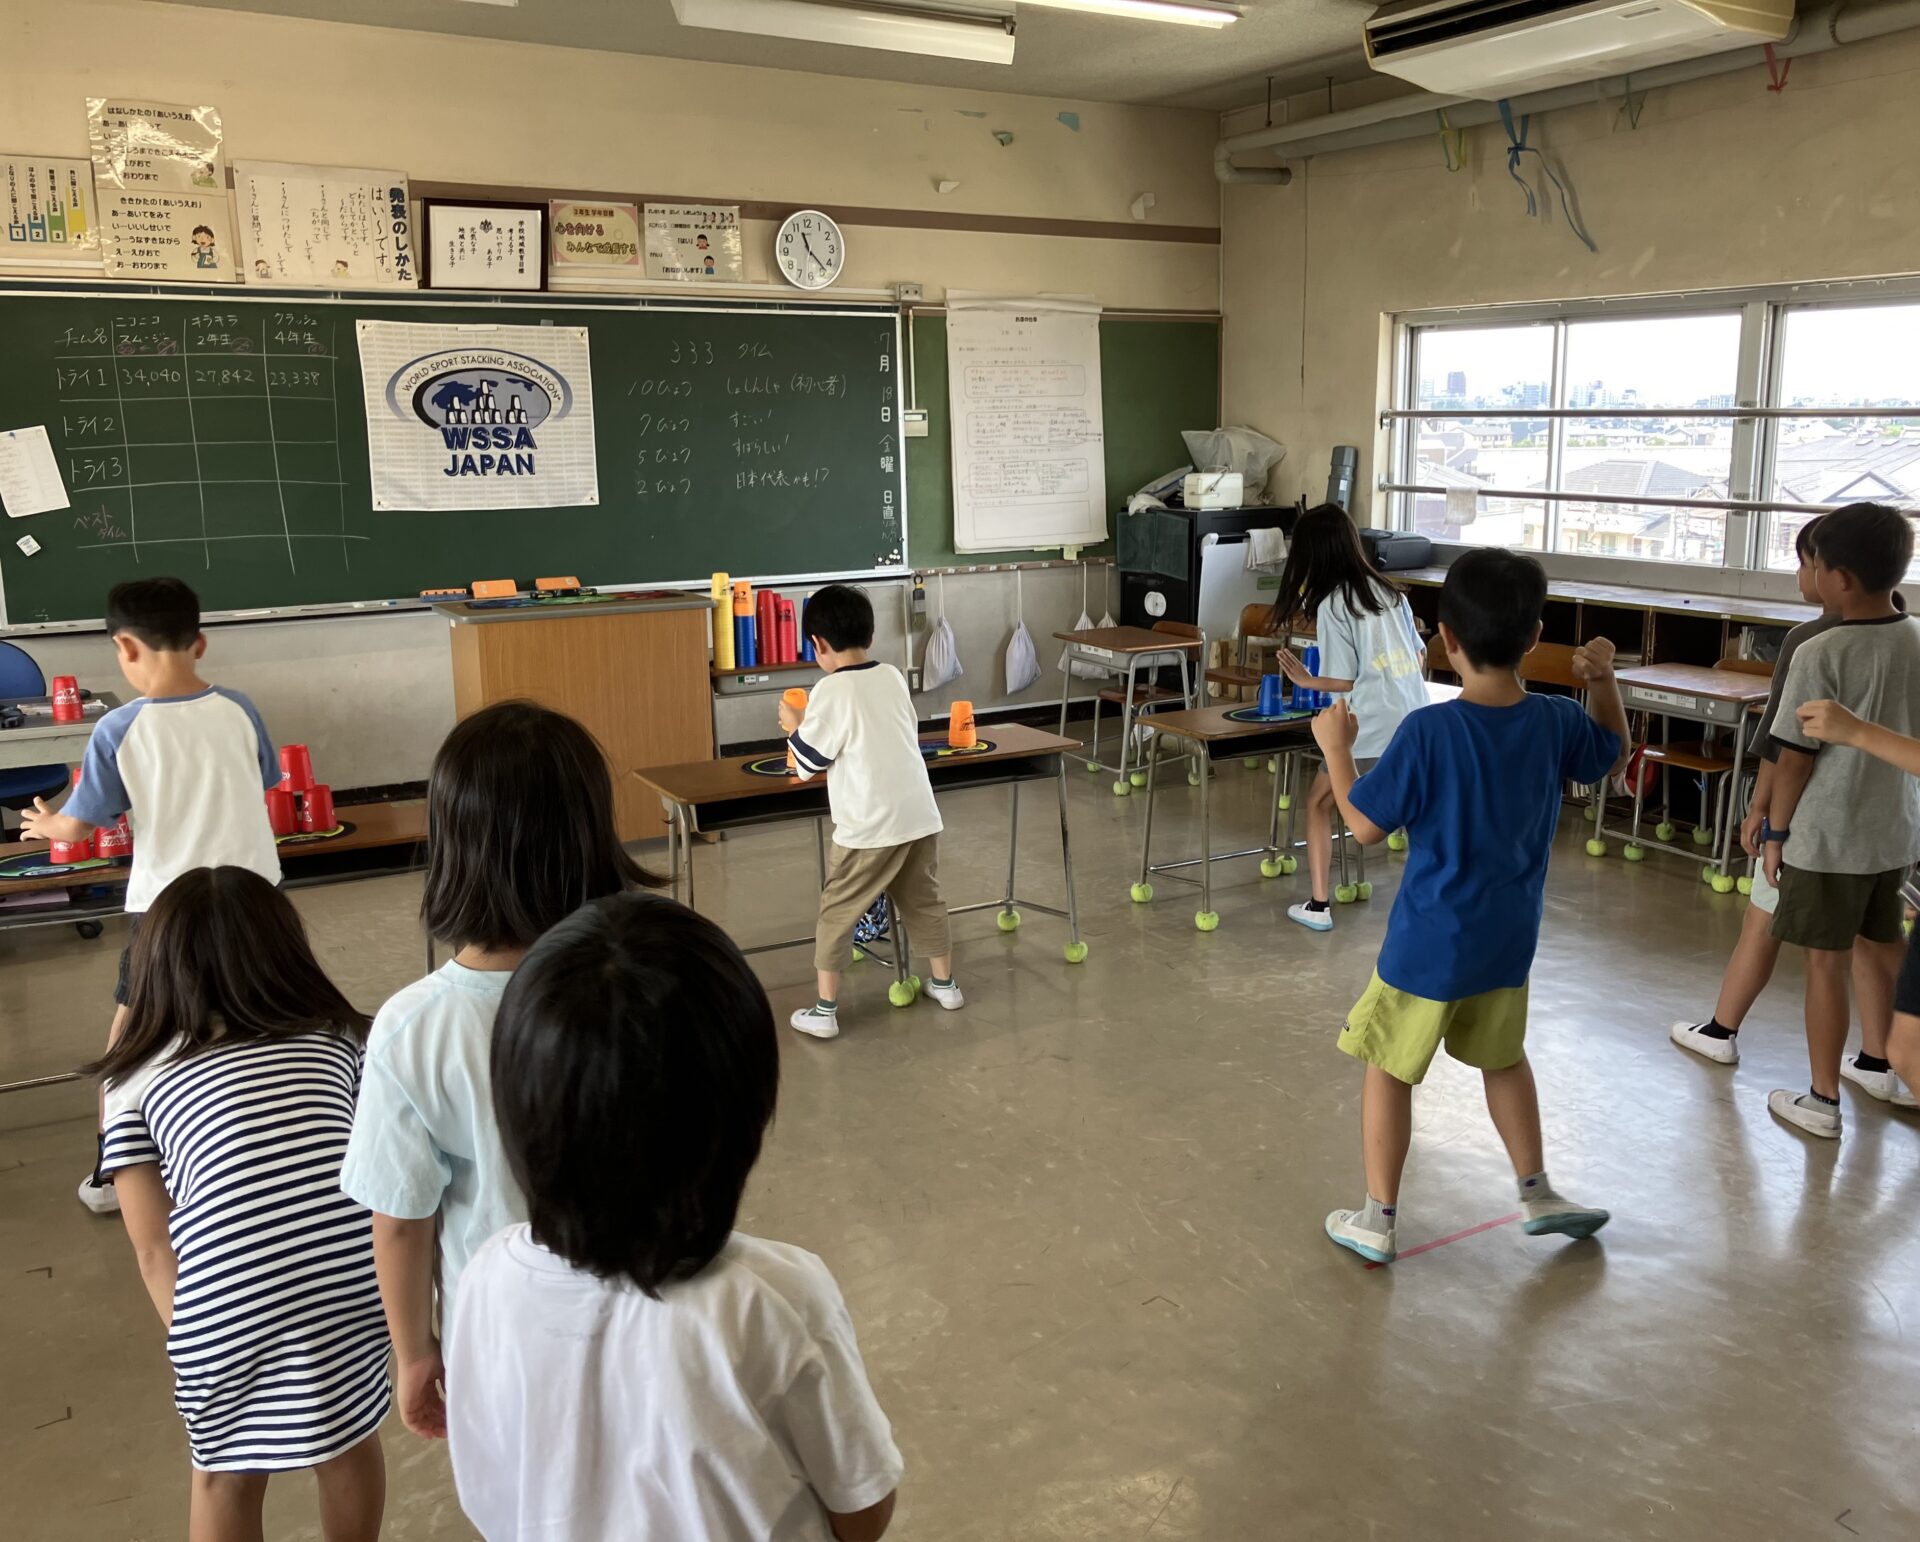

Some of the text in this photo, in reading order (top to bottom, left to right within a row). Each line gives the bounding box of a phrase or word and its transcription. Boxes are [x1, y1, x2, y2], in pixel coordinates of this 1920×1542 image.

[120, 197, 202, 209] ききかたの「あいうえお」
[555, 221, 605, 237] 心を向ける
[792, 223, 800, 232] 11
[803, 218, 812, 229] 12
[817, 222, 821, 232] 1
[389, 187, 413, 281] 発表のしかた
[784, 233, 793, 244] 10
[824, 231, 831, 241] 2
[496, 227, 504, 262] 思いやりの
[517, 220, 526, 275] 学校地域教育目標
[566, 241, 638, 256] みんなで成長する
[782, 246, 789, 257] 9
[828, 244, 835, 254] 3
[448, 240, 457, 268] 生きる子
[486, 248, 494, 269] ある子
[787, 260, 794, 270] 8
[825, 258, 833, 267] 4
[796, 268, 803, 278] 7
[807, 271, 814, 281] 6
[115, 315, 161, 328] ニコニコ
[191, 314, 239, 329] キラキラ
[196, 333, 233, 346] 2年生
[273, 329, 321, 346] 4年生
[738, 342, 774, 360] タイム
[402, 367, 430, 392] WORLD
[430, 357, 458, 372] SPORT
[461, 355, 505, 366] STACKING
[726, 375, 782, 395] しょしんしゃ
[441, 426, 538, 451] WSSA
[443, 453, 536, 477] JAPAN
